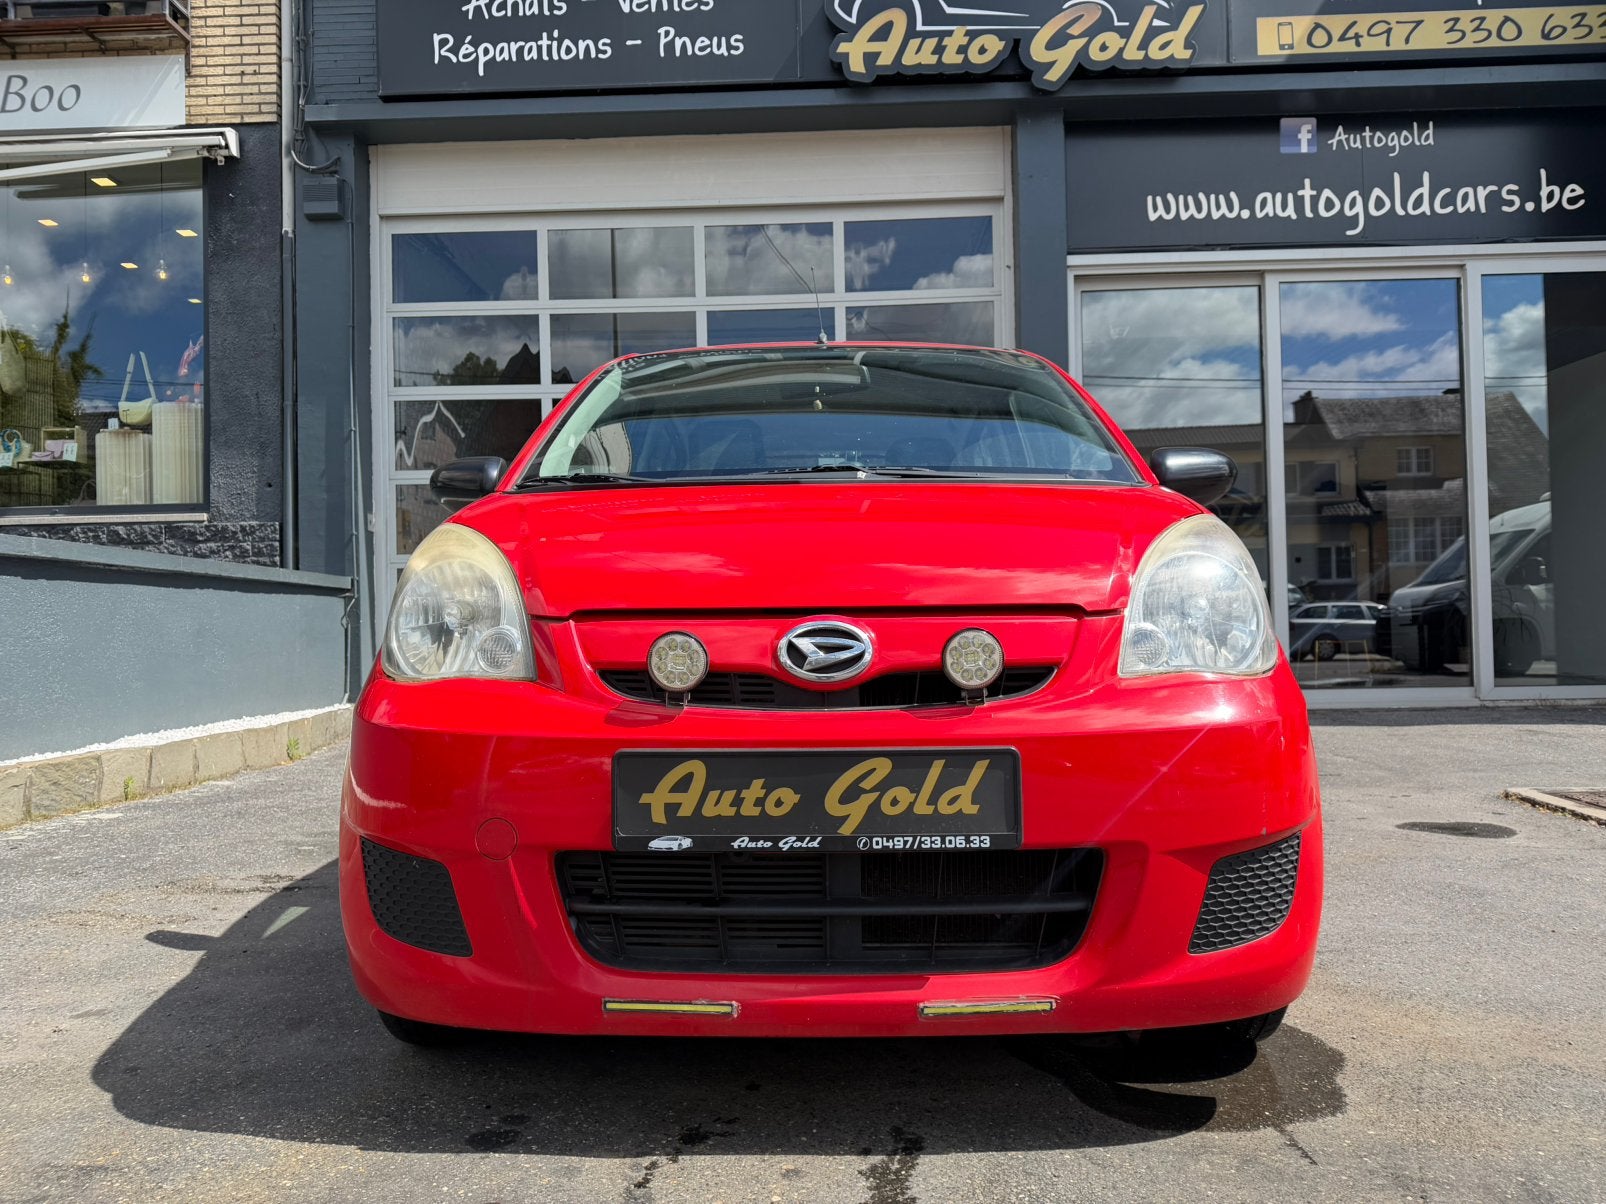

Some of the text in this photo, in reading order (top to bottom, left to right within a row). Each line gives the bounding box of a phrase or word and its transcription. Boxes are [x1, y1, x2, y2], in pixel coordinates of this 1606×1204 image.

[432, 29, 612, 76] Réparations
[657, 26, 744, 57] Pneus
[836, 3, 1204, 82] Auto Gold
[1306, 19, 1425, 49] 0497
[1443, 15, 1523, 45] 330
[0, 74, 82, 114] Boo
[1327, 121, 1434, 157] Autogold
[1146, 168, 1586, 236] www.autogoldcars.be
[638, 757, 991, 836] Auto Gold
[730, 835, 991, 851] Auto Gold 0497/33.06.33
